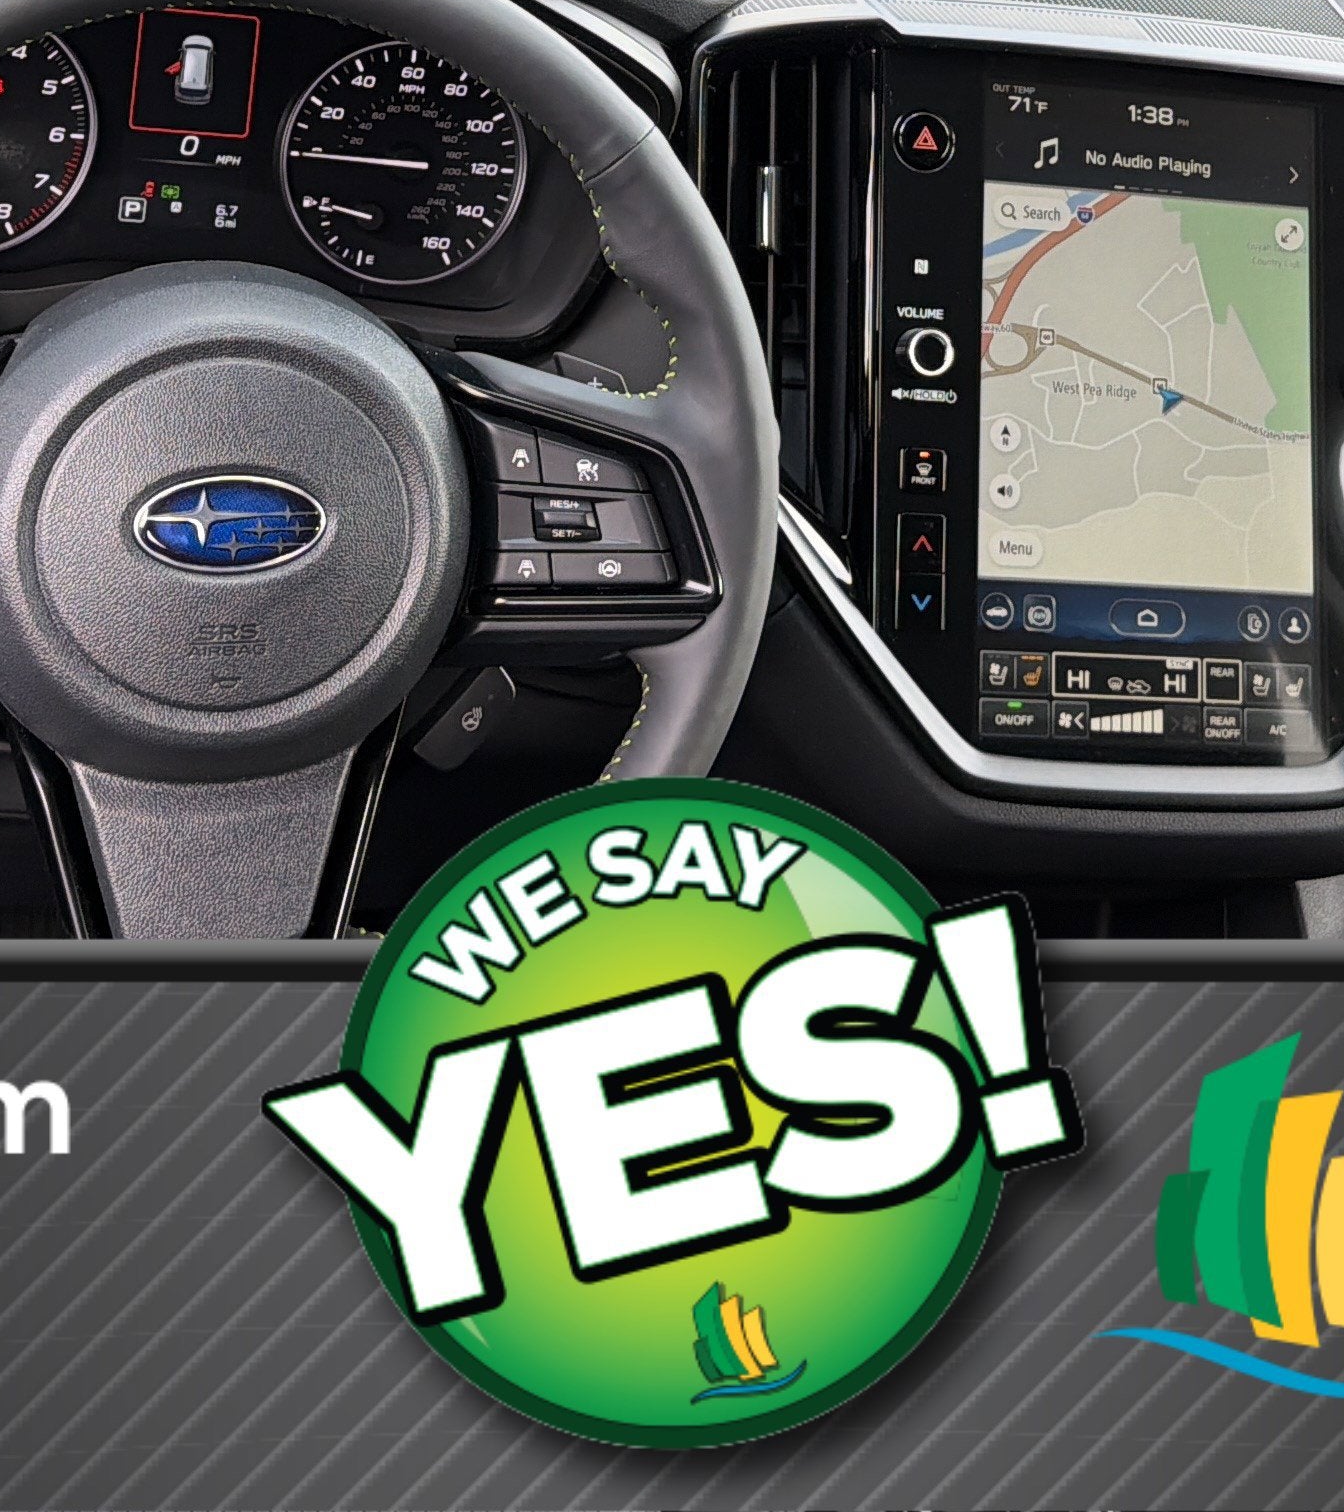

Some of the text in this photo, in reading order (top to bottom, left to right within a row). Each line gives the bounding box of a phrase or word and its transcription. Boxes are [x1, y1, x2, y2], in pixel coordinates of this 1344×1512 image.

[11, 45, 28, 60] 4
[400, 66, 426, 80] 60
[41, 79, 59, 95] 5
[350, 75, 377, 89] 40
[398, 83, 426, 95] MPH
[992, 83, 1036, 95] OUT TEMP
[443, 84, 469, 97] 80
[320, 107, 345, 121] 20
[1127, 104, 1174, 126] 1:38
[465, 119, 494, 133] 100
[48, 126, 66, 143] 6
[179, 135, 200, 156] 0
[215, 154, 242, 167] MPH
[1085, 149, 1212, 179] No Audio Playing
[470, 162, 499, 177] 120
[33, 173, 51, 189] 7
[124, 200, 141, 218] P
[215, 204, 239, 217] 6.7
[455, 204, 485, 219] 140
[1023, 204, 1061, 221] Search
[422, 236, 451, 251] 160
[365, 254, 375, 265] E
[896, 306, 945, 321] VOLUME
[1052, 380, 1137, 400] West Pea Ridge
[999, 540, 1033, 556] Menu
[1067, 669, 1090, 690] HI
[1209, 667, 1234, 678] REAR
[1164, 673, 1187, 694] HI
[994, 714, 1034, 727] ON/OFF
[1209, 716, 1236, 727] REAR
[1205, 727, 1241, 739] ON/OFF
